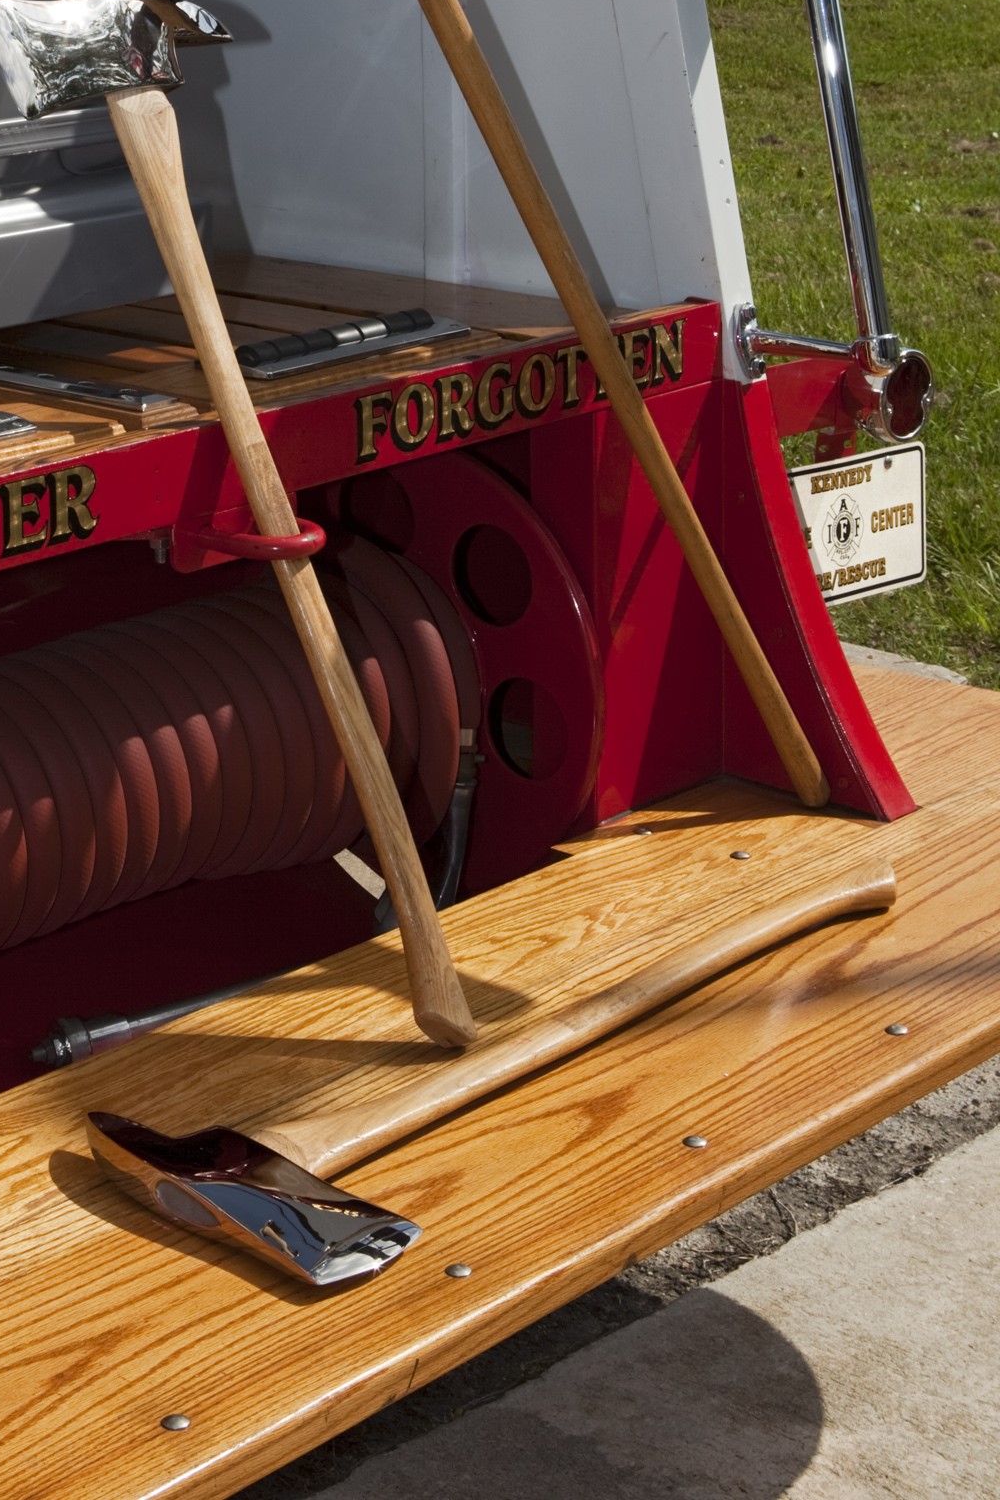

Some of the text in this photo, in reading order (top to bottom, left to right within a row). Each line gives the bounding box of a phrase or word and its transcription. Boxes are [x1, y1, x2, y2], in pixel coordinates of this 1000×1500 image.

[354, 317, 688, 465] FORGOTEN
[811, 464, 873, 495] KENNEDY
[871, 503, 914, 534] CENTER
